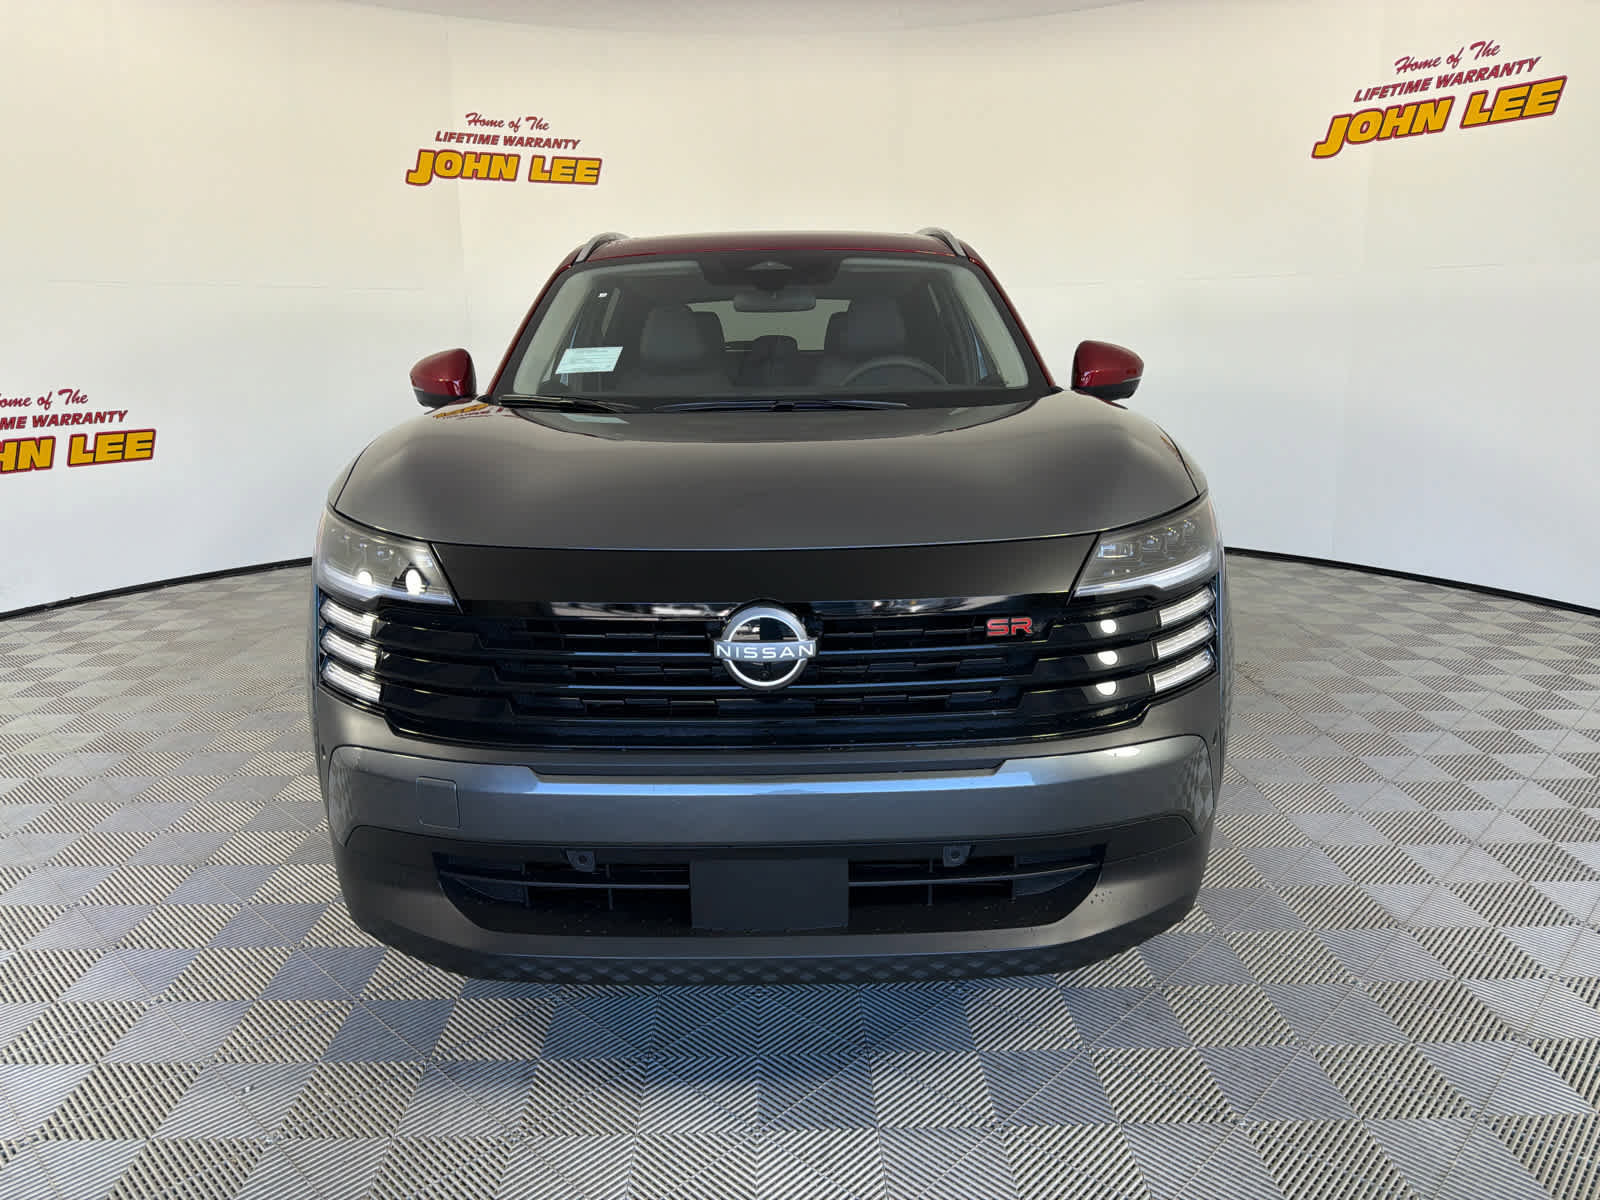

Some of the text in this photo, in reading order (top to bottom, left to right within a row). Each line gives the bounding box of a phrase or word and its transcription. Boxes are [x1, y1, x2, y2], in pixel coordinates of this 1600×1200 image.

[1394, 40, 1501, 75] Home of The
[1353, 56, 1542, 103] LIFETIME WARRANTY
[465, 112, 550, 133] Home of The
[1311, 75, 1568, 159] JOHN LEE
[435, 131, 581, 150] LIFETIME WARRANTY
[406, 148, 602, 186] JOHN LEE
[0, 388, 89, 410] ome of The
[32, 410, 129, 428] WARRANTY
[66, 428, 157, 468] LEE
[987, 617, 1032, 637] SR
[716, 643, 814, 658] NISSAN
